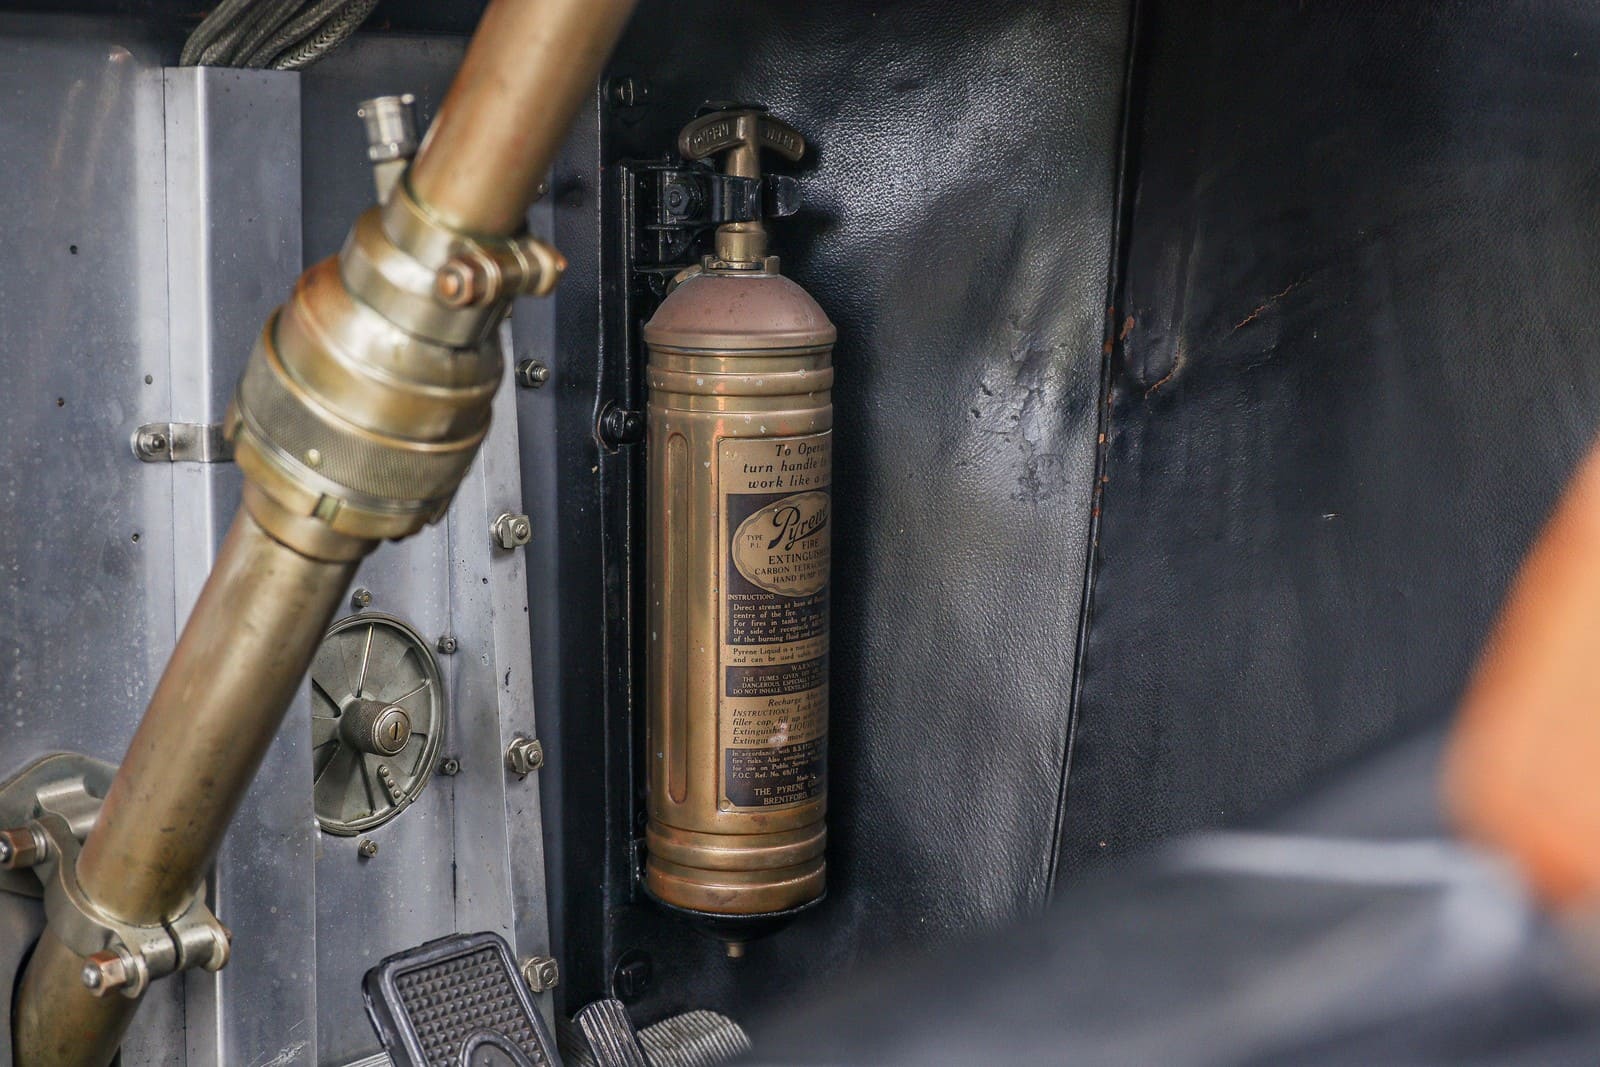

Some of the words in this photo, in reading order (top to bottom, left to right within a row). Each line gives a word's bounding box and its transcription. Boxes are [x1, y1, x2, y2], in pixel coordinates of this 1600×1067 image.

[776, 444, 791, 456] To
[744, 463, 773, 473] turn
[781, 458, 817, 472] handle
[748, 476, 783, 488] work
[790, 474, 809, 486] like
[802, 540, 818, 550] FIRE
[754, 566, 790, 576] CARBON
[773, 575, 796, 584] HAND
[760, 611, 767, 619] of
[734, 648, 757, 656] Pyrene
[760, 647, 780, 656] Liquid
[732, 718, 752, 726] filler
[778, 716, 788, 725] fill
[732, 764, 742, 772] for
[754, 788, 772, 796] THE
[776, 783, 804, 794] PYRENE
